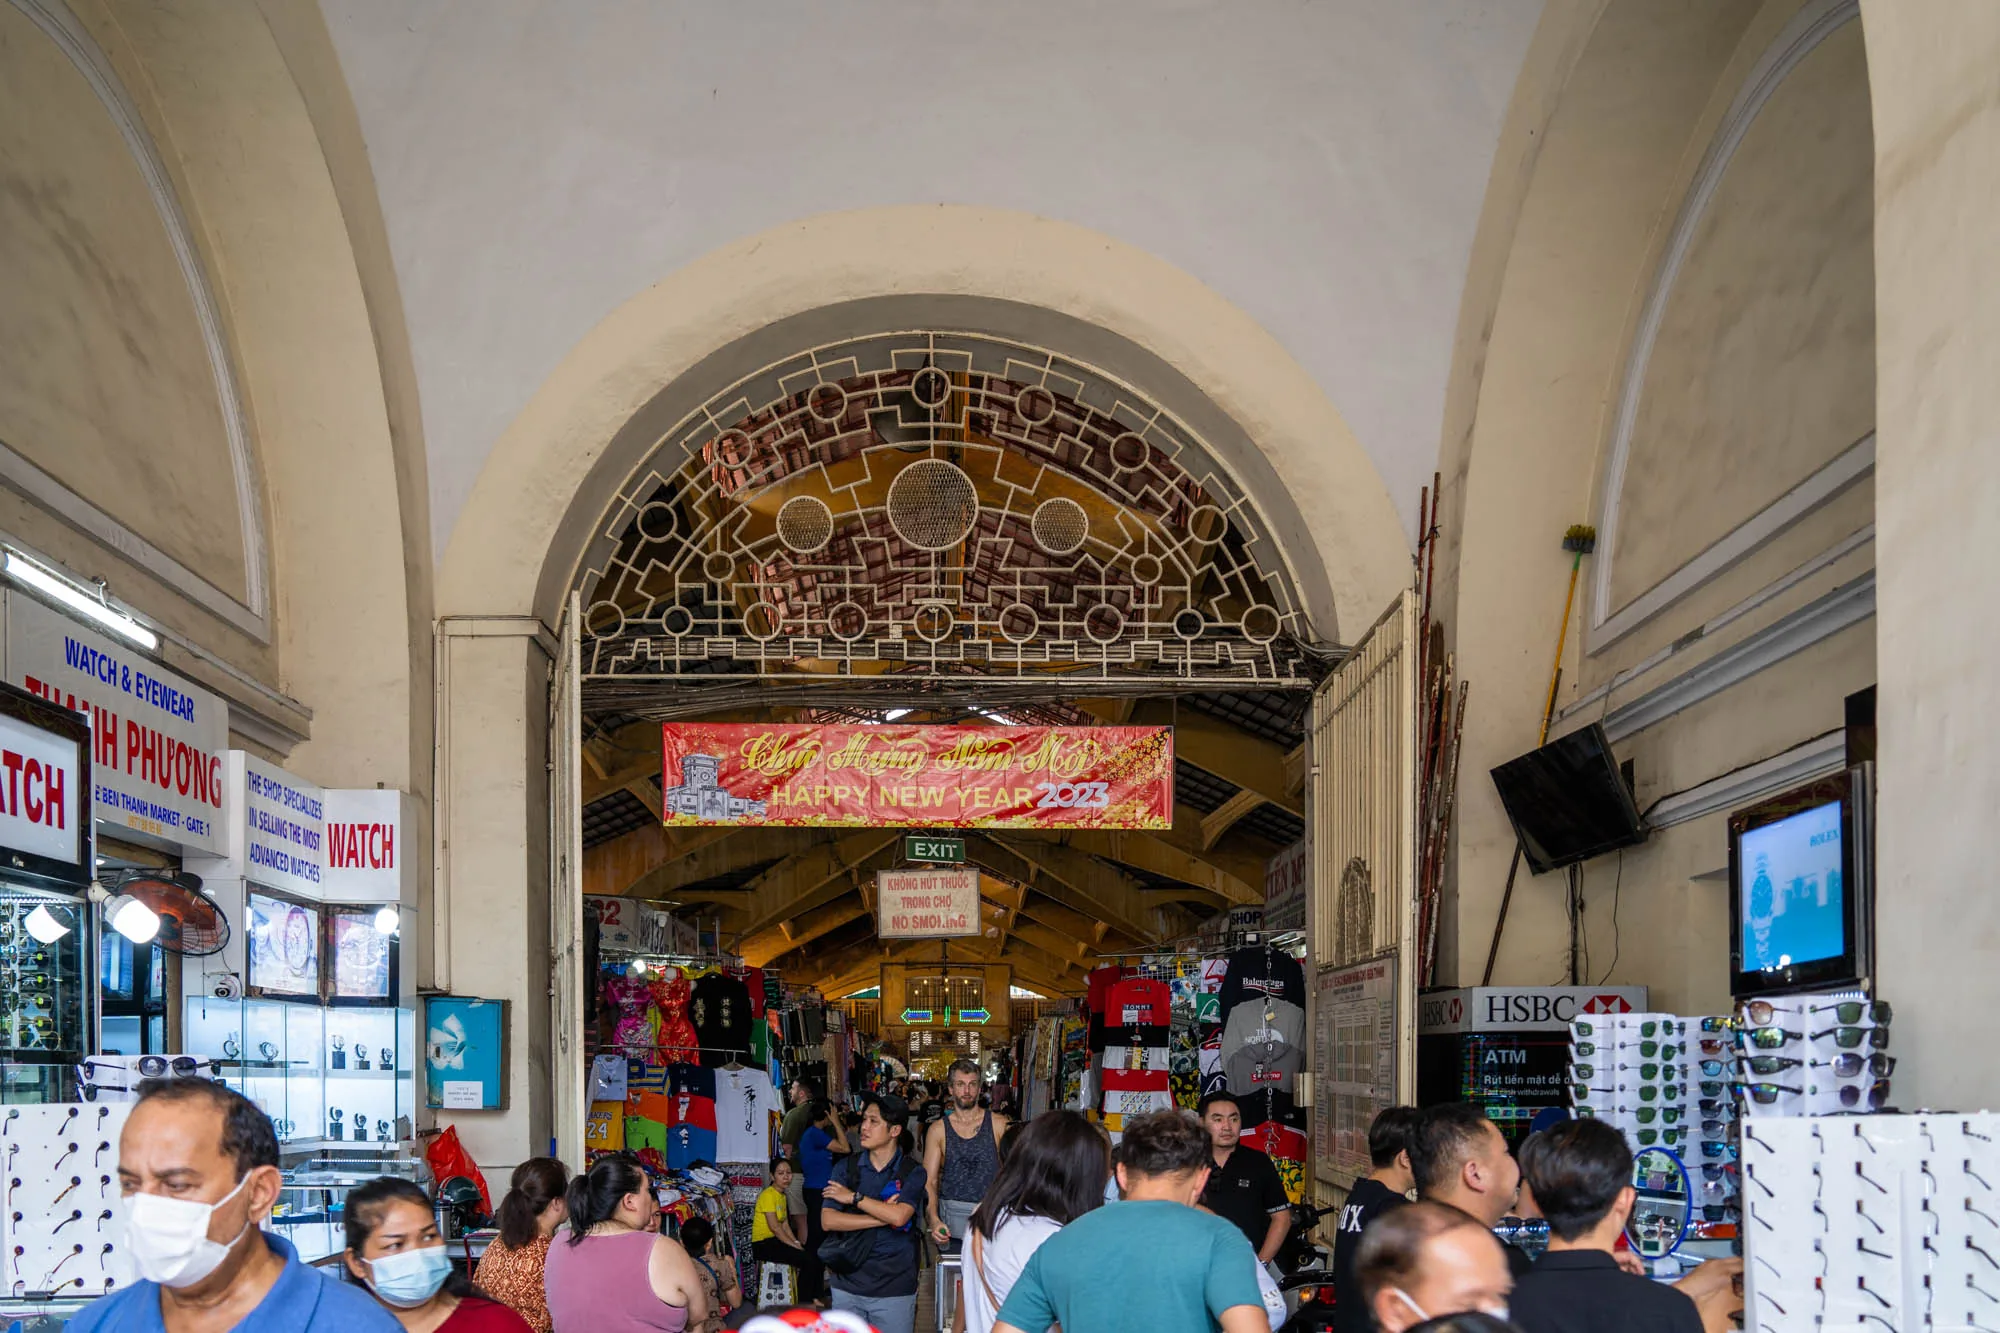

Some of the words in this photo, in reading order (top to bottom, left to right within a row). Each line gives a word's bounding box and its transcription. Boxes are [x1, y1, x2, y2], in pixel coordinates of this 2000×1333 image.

[65, 636, 117, 687] WATCH
[121, 665, 132, 693] &
[136, 671, 194, 723] EYEWEAR
[127, 719, 222, 809] PHƯƠNG
[741, 731, 823, 777] Chúc
[827, 731, 930, 781] Mừng
[935, 733, 1016, 772] Năm
[1021, 731, 1103, 778] Mới
[0, 749, 65, 830] TCH
[248, 770, 262, 794] THE
[263, 776, 282, 801] SHOP
[283, 786, 322, 820] SPECIALIZES
[772, 785, 871, 807] HAPPY
[879, 786, 946, 808] NEW
[953, 787, 1034, 808] YEAR
[1036, 782, 1110, 809] 2023
[102, 787, 119, 807] BEN
[121, 793, 148, 816] THANH
[150, 803, 181, 828] MARKET
[186, 816, 204, 835] GATE
[248, 806, 257, 828] IN
[259, 811, 287, 839] SELLING
[289, 822, 301, 844] THE
[302, 830, 320, 852] MOST
[1810, 829, 1839, 847] ROLEX
[327, 823, 394, 870] WATCH
[914, 842, 957, 858] EXIT
[249, 842, 289, 873] ADVANCED
[290, 855, 320, 884] WATCHES
[887, 875, 918, 891] KHÔNG
[920, 873, 938, 890] HÚT
[940, 872, 969, 889] THUỐC
[901, 895, 931, 909] TRONG
[933, 891, 952, 911] CHỢ
[892, 915, 909, 930] NO
[1231, 911, 1262, 926] SHOP
[1242, 976, 1284, 988] Balencaga
[1424, 1000, 1448, 1027] HSBC
[1486, 995, 1576, 1023] HSBC
[1485, 1049, 1527, 1064] ATM
[1484, 1074, 1503, 1085] Rút
[1527, 1075, 1546, 1086] mặt
[1549, 1072, 1560, 1085] dễ
[1517, 1088, 1560, 1096] withdrawals
[586, 1121, 608, 1140] 24
